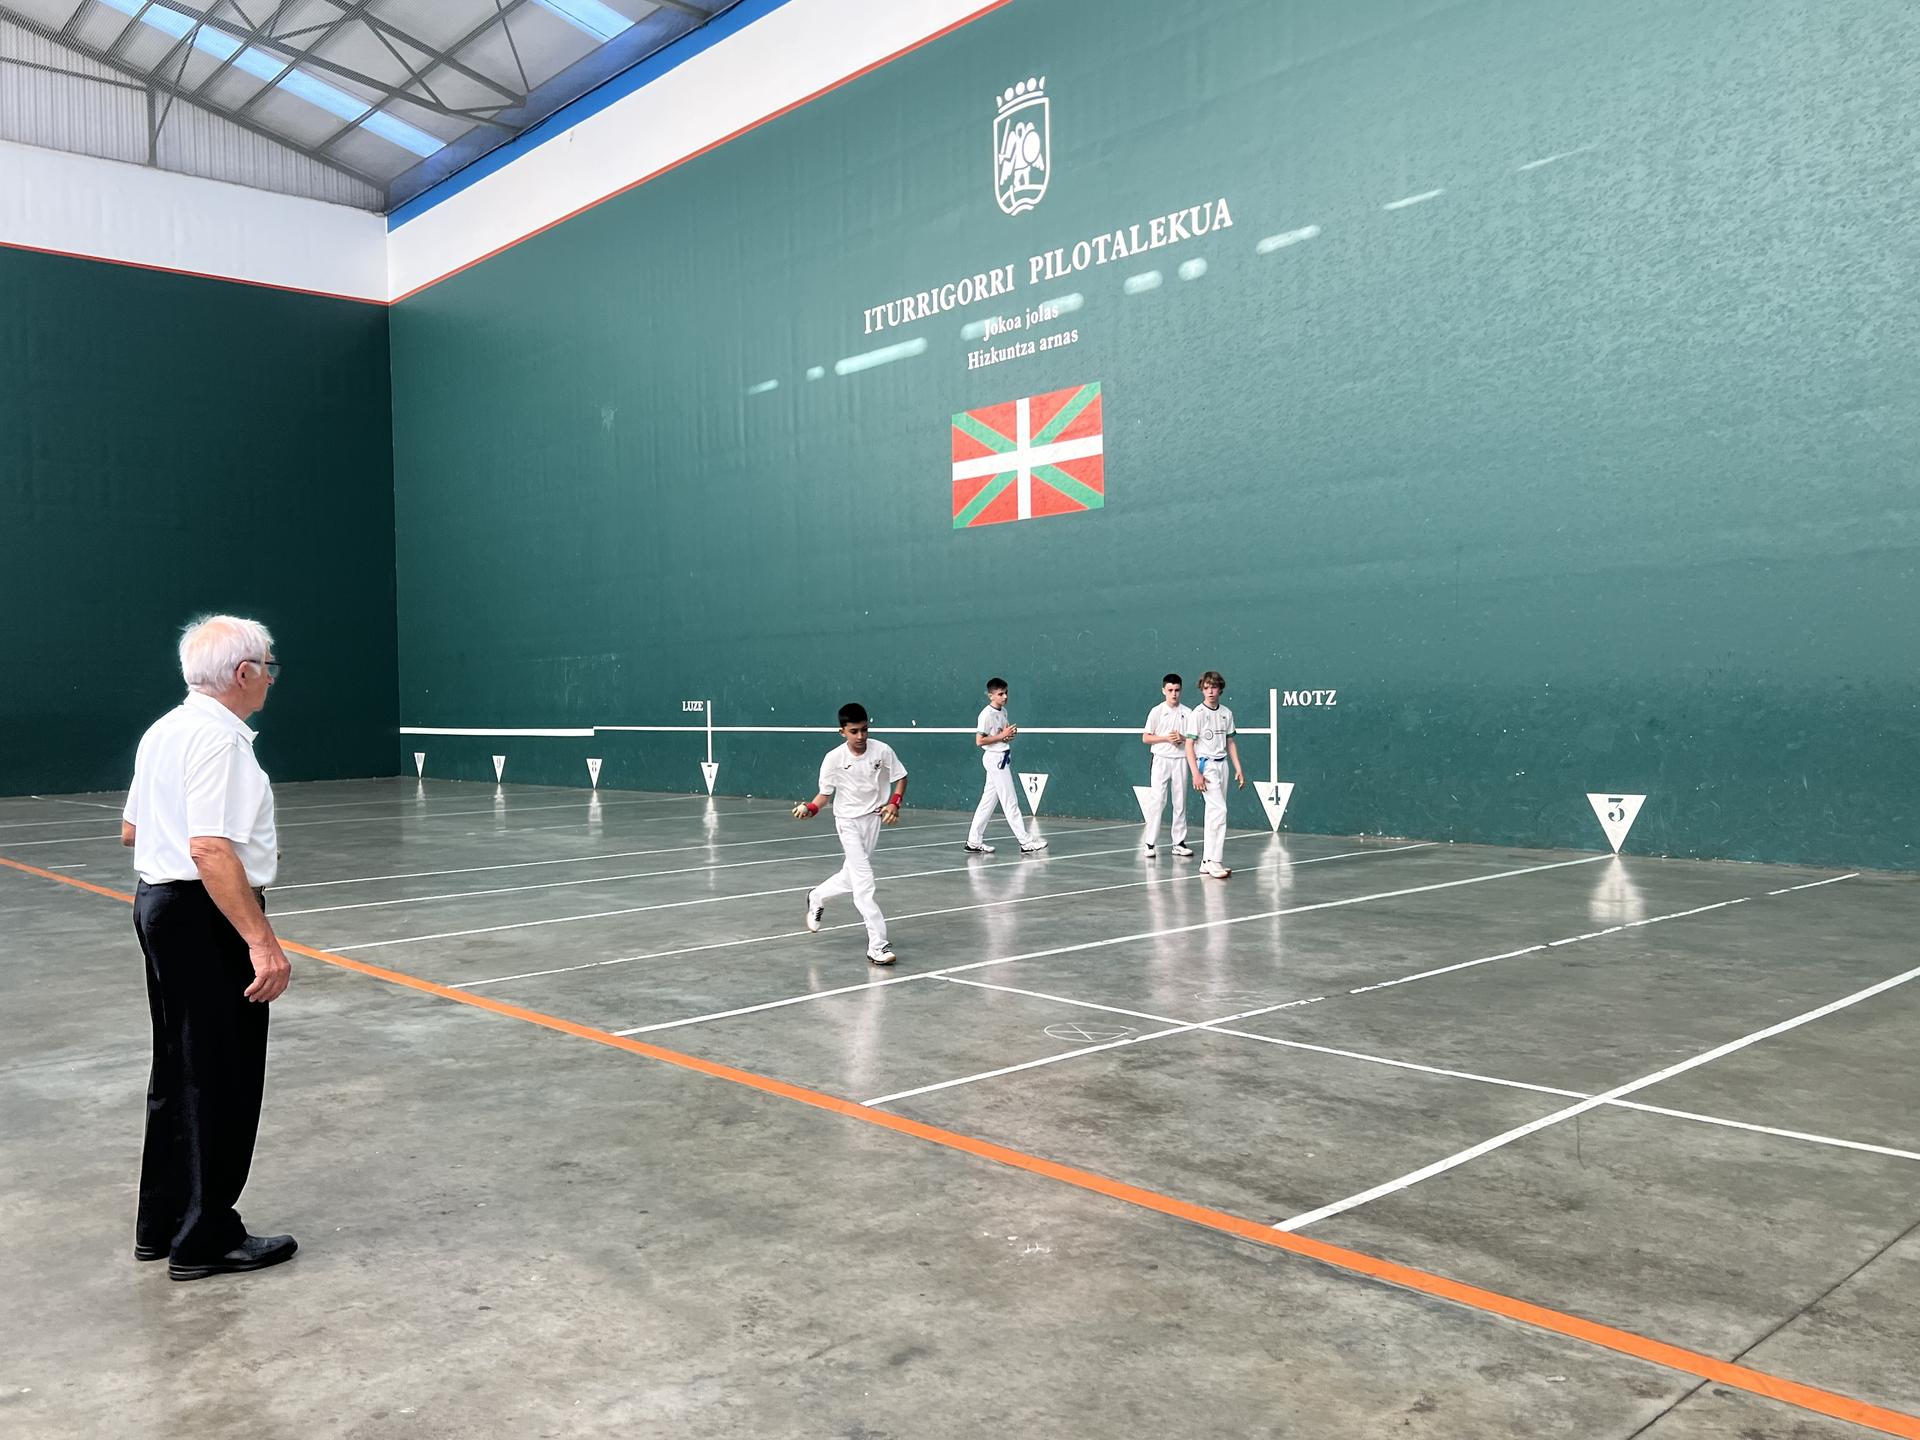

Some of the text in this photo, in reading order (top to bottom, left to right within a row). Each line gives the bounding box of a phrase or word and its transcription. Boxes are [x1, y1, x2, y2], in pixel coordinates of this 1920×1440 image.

[863, 197, 1233, 335] ITURRIGORRI PILOTALEKUA
[983, 303, 1059, 341] Jokoa jolas
[967, 327, 1079, 370] Hizkuntza arnas
[682, 700, 704, 712] LUZE
[1282, 690, 1337, 707] MOTZ
[591, 760, 597, 773] 8
[1029, 776, 1038, 793] 5
[1267, 785, 1281, 806] 4
[1607, 797, 1625, 822] 3
